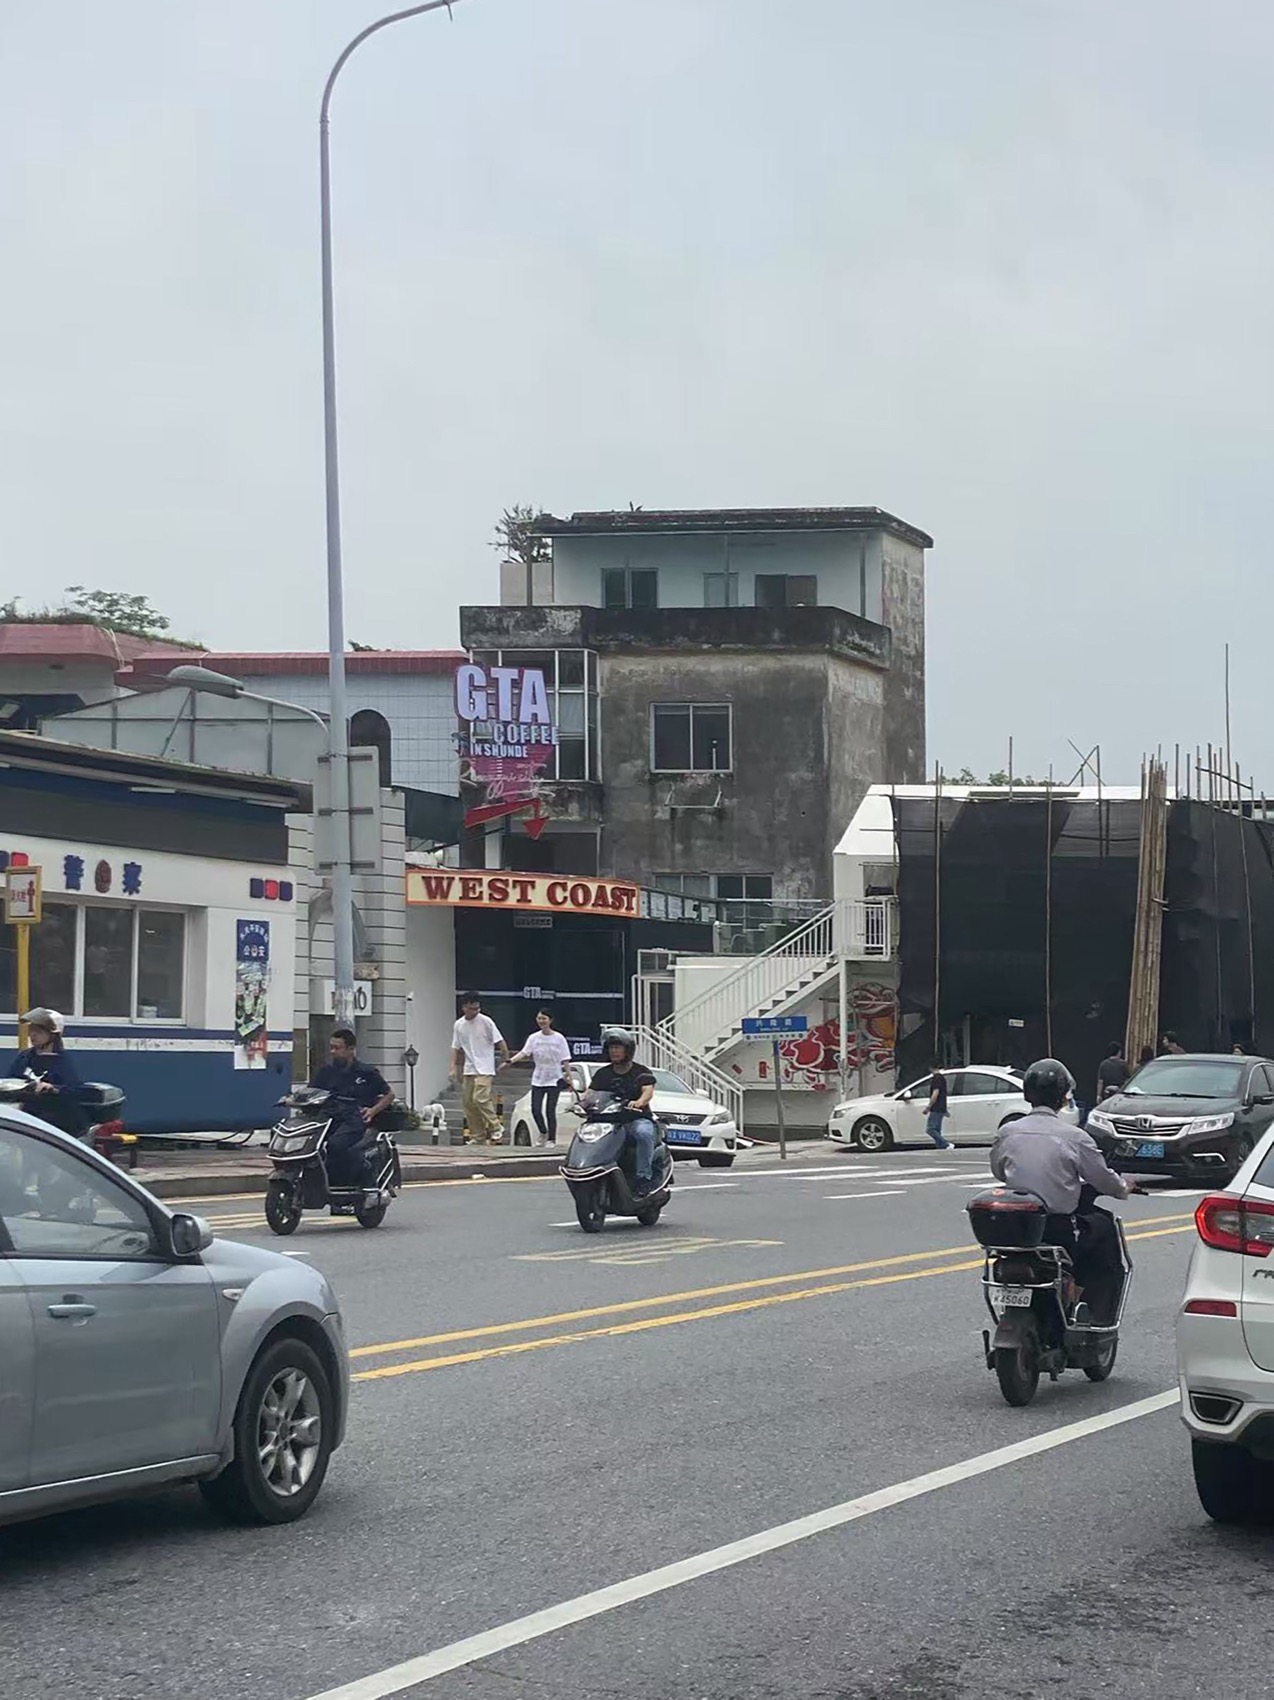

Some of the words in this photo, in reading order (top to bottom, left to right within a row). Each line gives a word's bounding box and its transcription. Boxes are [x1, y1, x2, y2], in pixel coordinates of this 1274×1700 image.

[456, 665, 550, 723] GTA
[493, 723, 559, 745] COFFEE
[484, 743, 529, 758] SHUNDE
[421, 876, 536, 903] WEST
[546, 881, 637, 911] COAST
[523, 986, 541, 999] GTA
[573, 1042, 591, 1055] GTA
